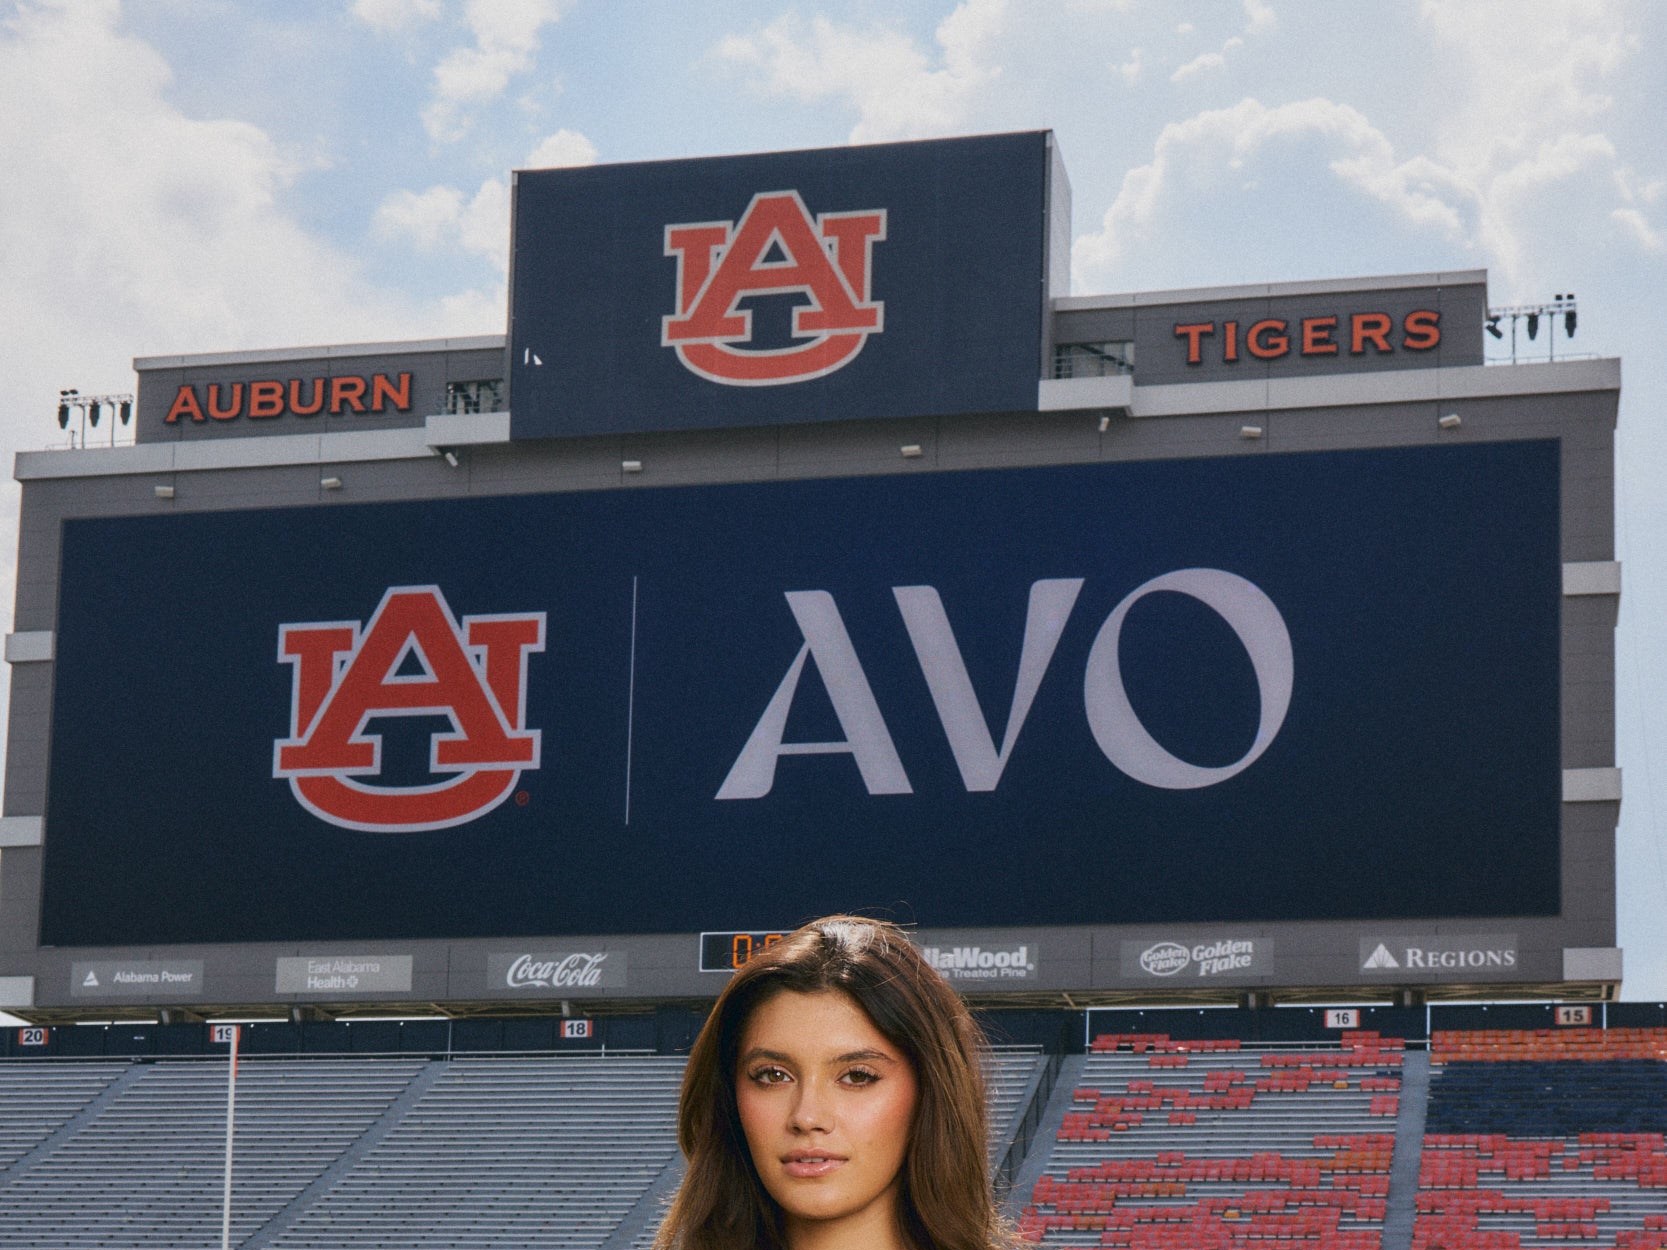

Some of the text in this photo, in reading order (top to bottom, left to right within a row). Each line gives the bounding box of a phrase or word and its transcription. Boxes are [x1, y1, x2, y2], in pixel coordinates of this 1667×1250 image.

[1175, 310, 1441, 363] TIGERS
[165, 373, 411, 423] AUBURN
[714, 567, 1294, 800] AVO
[1143, 948, 1187, 962] Golden
[1192, 940, 1253, 961] Golden
[308, 960, 380, 973] East Alabama
[506, 953, 608, 987] Coca-Cola
[1149, 957, 1186, 970] Flake
[1200, 954, 1252, 976] Flake
[113, 970, 193, 983] Alabama Power
[953, 969, 998, 978] Treated
[1000, 967, 1026, 977] Pine
[307, 976, 346, 989] Health
[1334, 1012, 1349, 1025] 16
[1563, 1010, 1584, 1022] 15
[567, 1022, 586, 1036] 18
[24, 1030, 43, 1043] 20
